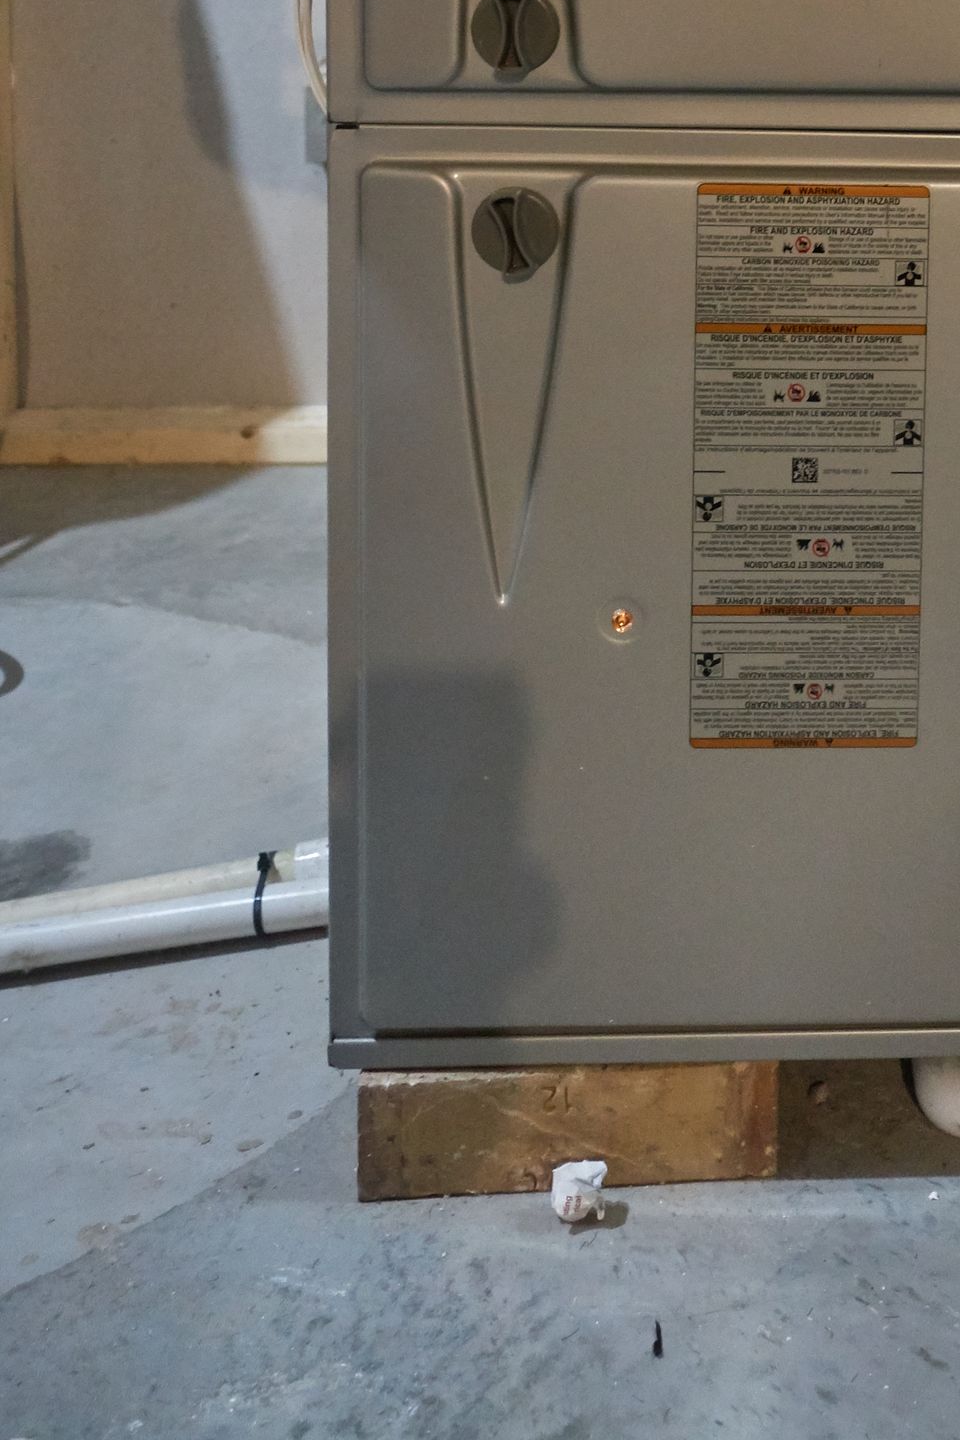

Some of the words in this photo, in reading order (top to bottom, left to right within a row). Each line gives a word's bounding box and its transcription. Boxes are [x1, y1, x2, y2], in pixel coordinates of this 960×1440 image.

[799, 187, 845, 196] WARNING
[739, 196, 786, 204] EXPLOSION
[788, 196, 804, 204] AND
[806, 197, 866, 205] ASPHYXIATION
[867, 197, 900, 205] HAZARD
[790, 227, 837, 235] EXPLOSION
[780, 325, 858, 333] AVERTISSEMENT
[742, 335, 787, 343] D'INCENDIE,
[790, 335, 842, 343] D'EXPLOSION
[856, 336, 903, 344] D'ASPHYXIE
[732, 371, 762, 379] RISQUE
[764, 372, 808, 380] D'INCENDIE
[810, 372, 820, 380] ET
[822, 372, 874, 380] D'EXPLOSION
[859, 410, 869, 418] DE
[744, 561, 795, 569] D'EXPLOSION
[797, 561, 807, 569] ET
[809, 561, 853, 569] D'INCENDIE
[855, 561, 884, 569] RISQUE
[759, 606, 837, 614] AVERTISSEMENT
[719, 730, 751, 738] HAZARD
[754, 730, 811, 738] ASPHYXIATION
[814, 730, 830, 738] AND
[831, 730, 877, 738] EXPLOSION
[880, 730, 899, 738] FIRE,
[773, 739, 818, 747] WARNING
